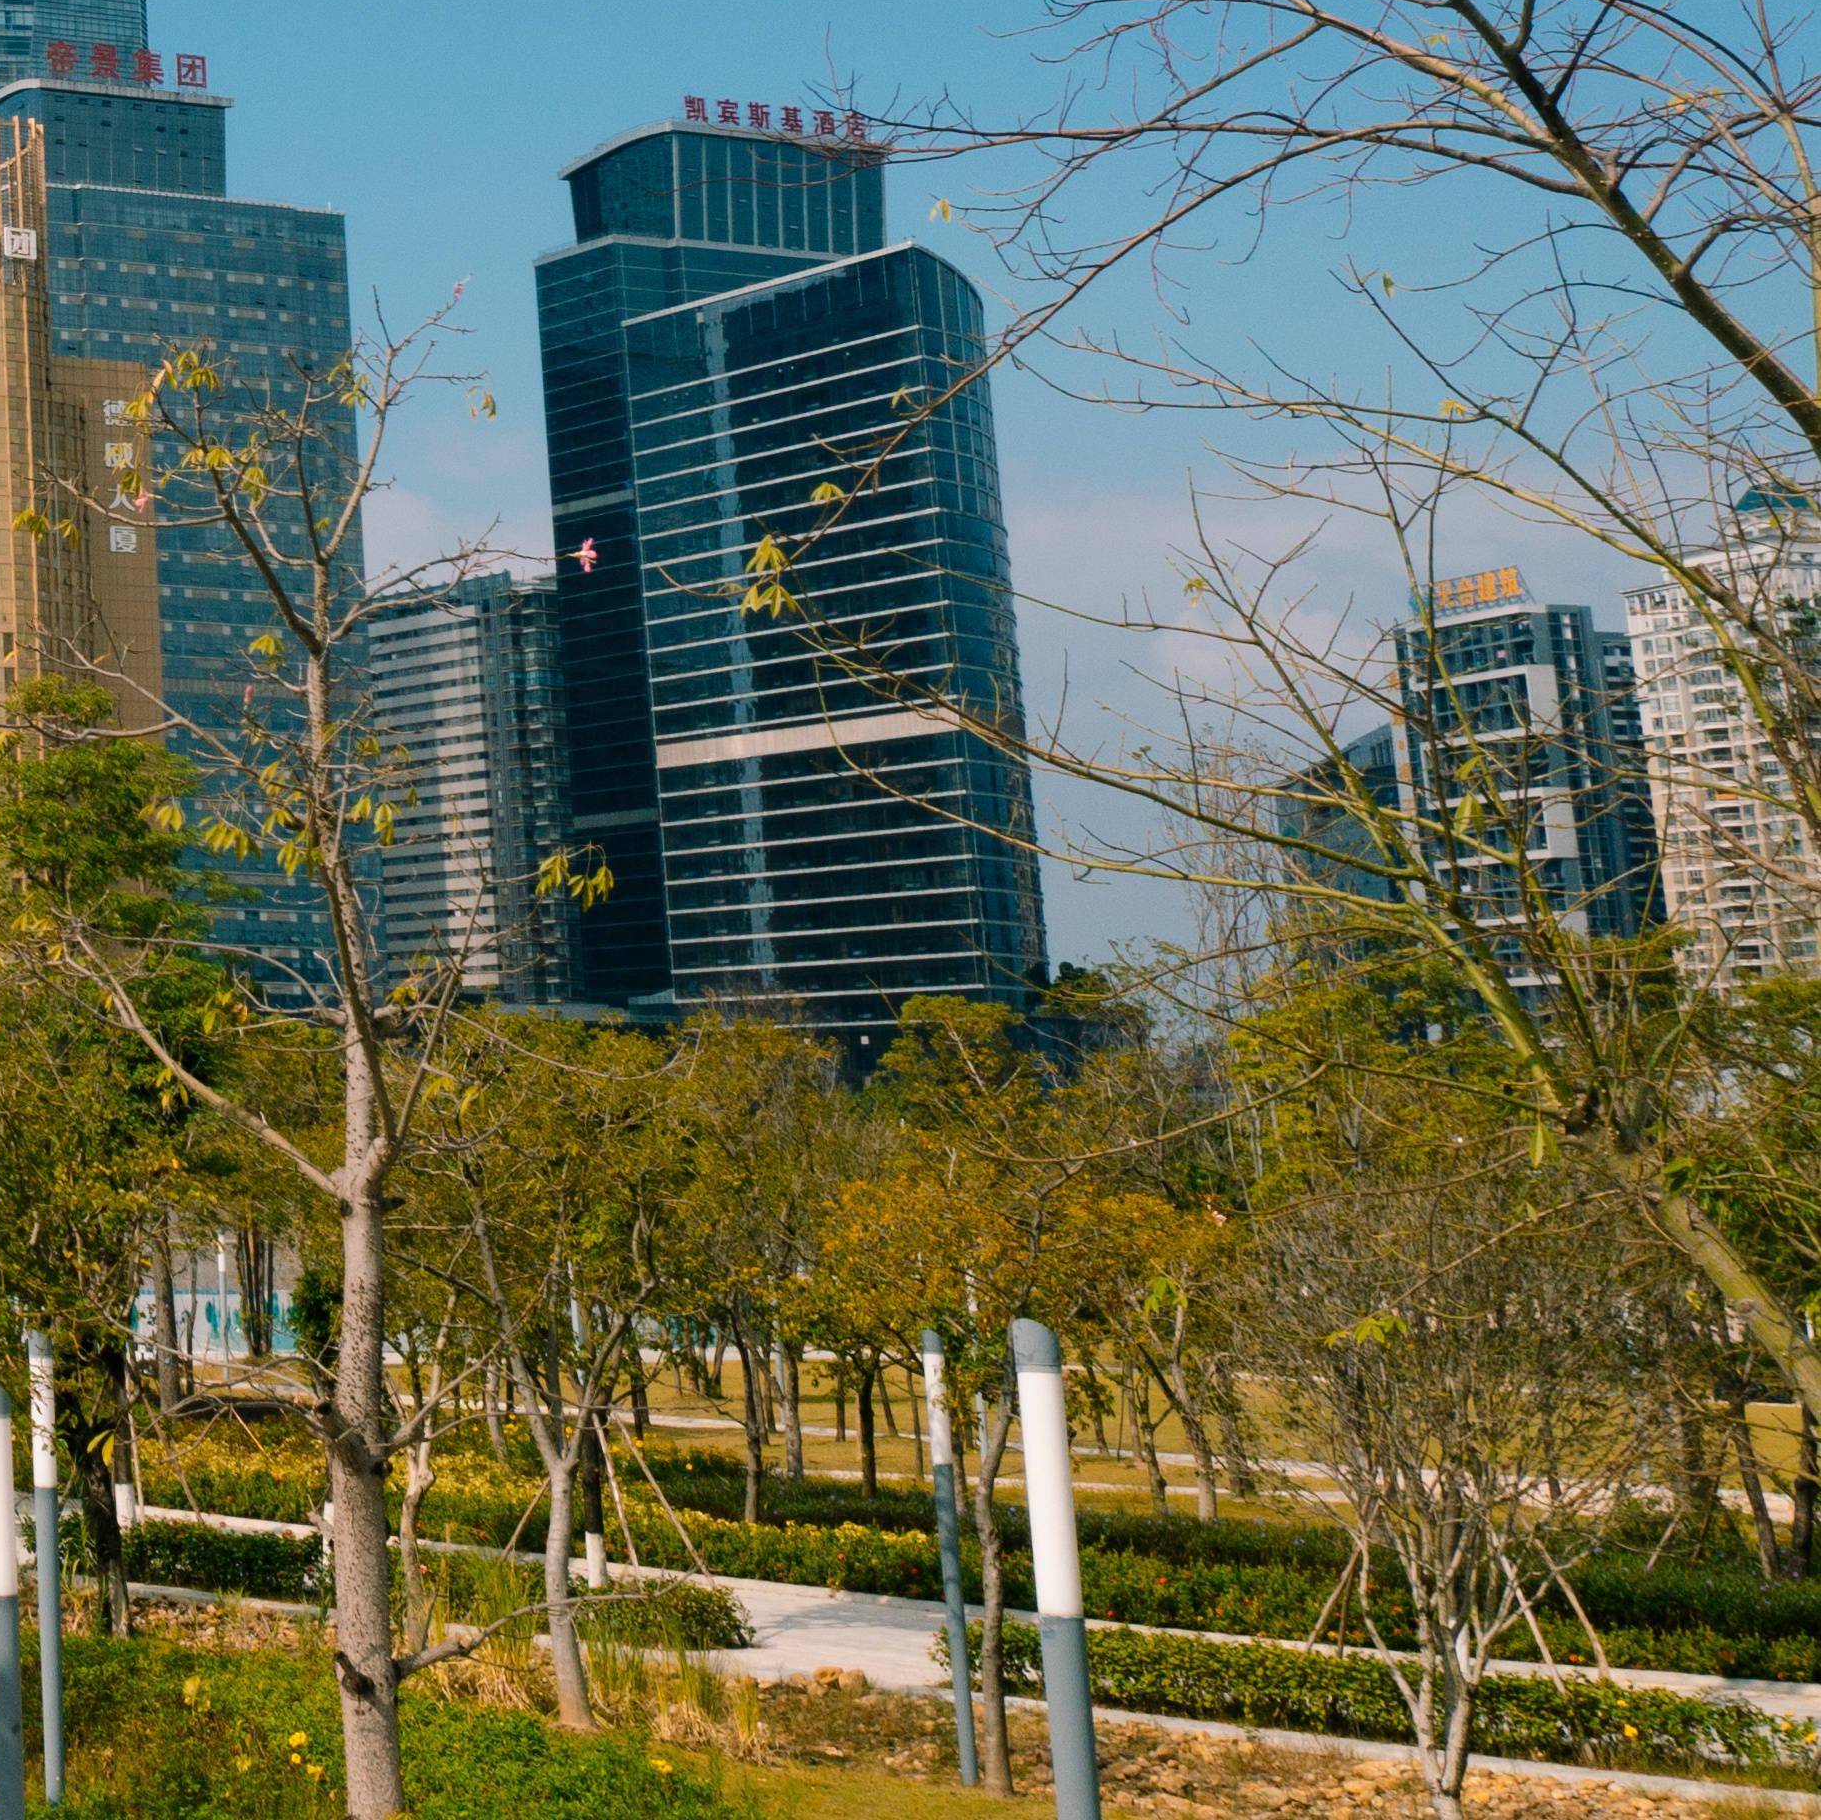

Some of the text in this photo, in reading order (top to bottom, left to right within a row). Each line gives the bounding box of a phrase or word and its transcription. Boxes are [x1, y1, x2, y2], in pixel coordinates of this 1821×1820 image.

[46, 40, 207, 88] 帝景集团
[684, 95, 868, 141] 凯宾斯基酒店
